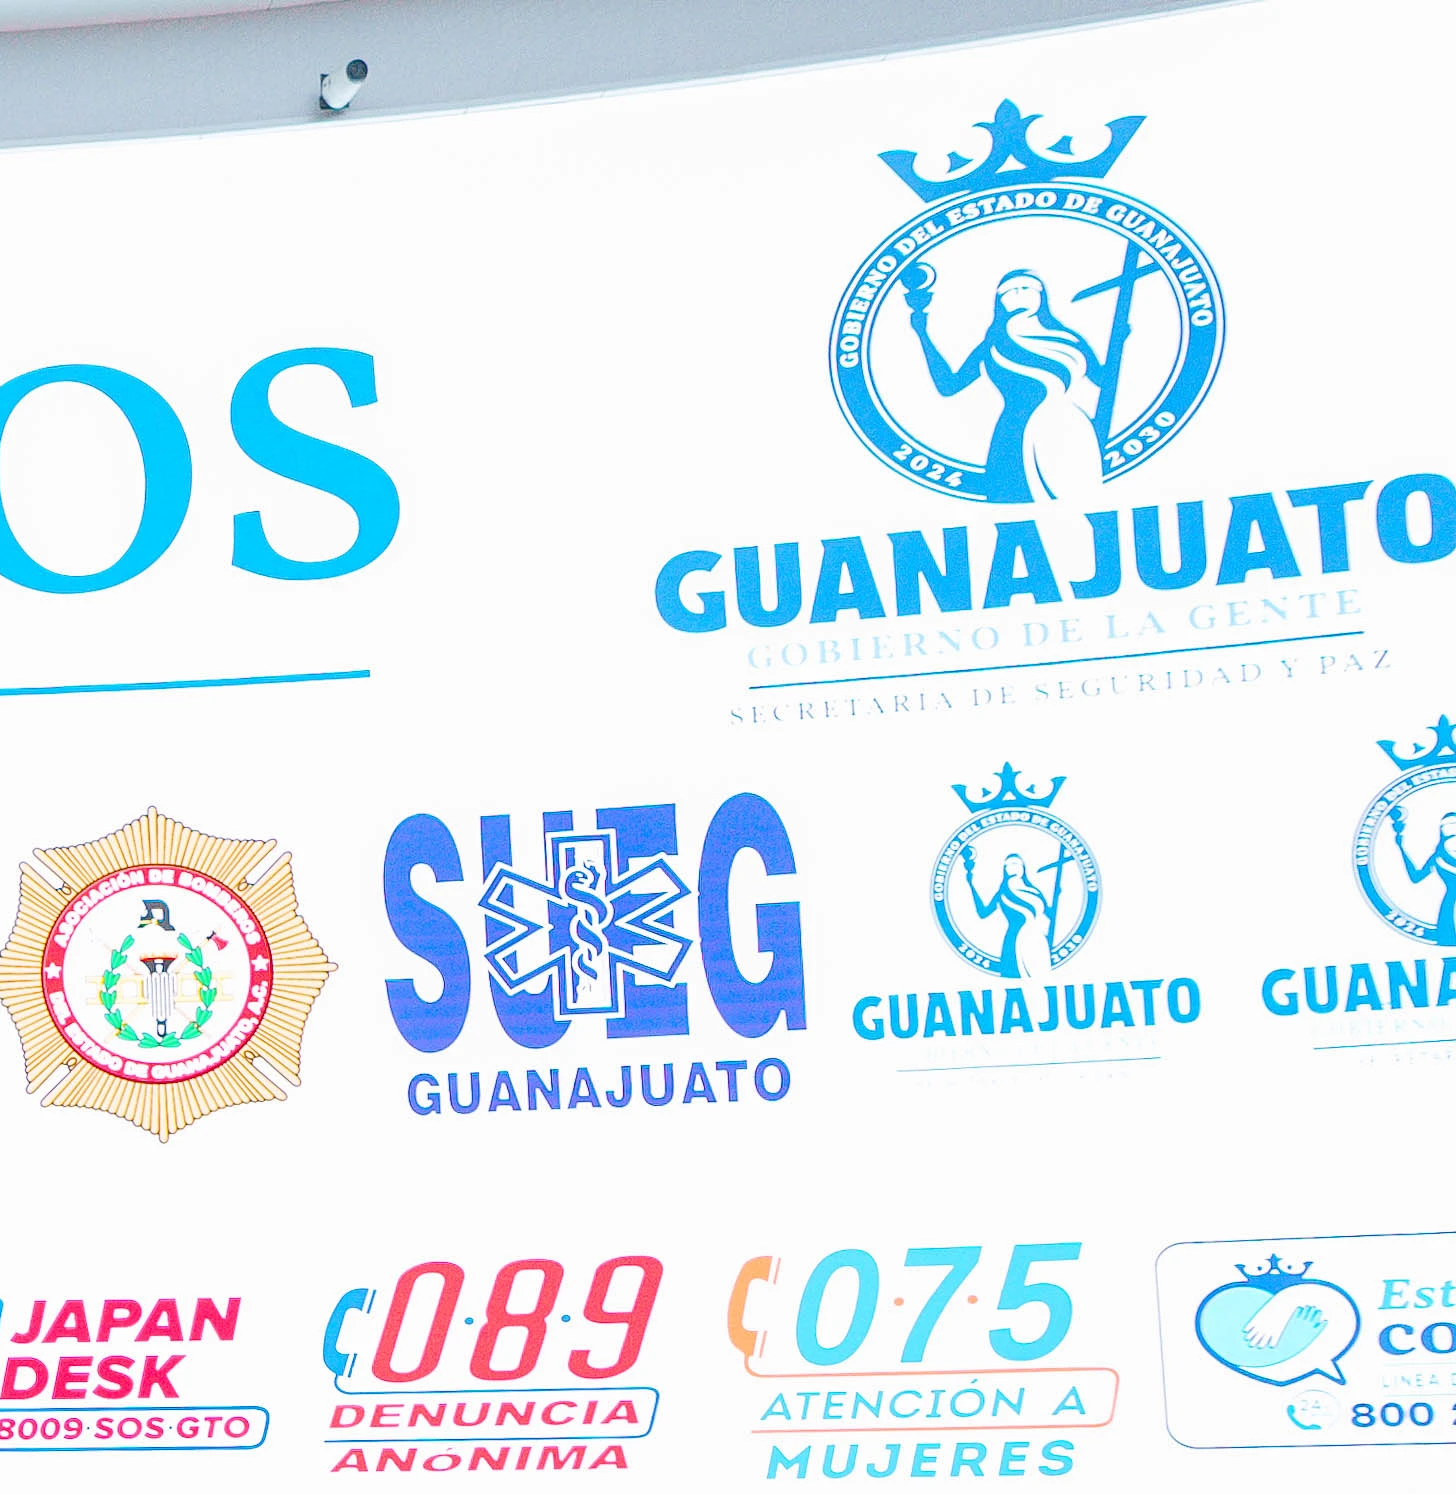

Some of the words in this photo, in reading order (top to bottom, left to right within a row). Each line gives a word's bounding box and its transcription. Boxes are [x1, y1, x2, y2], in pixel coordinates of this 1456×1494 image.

[840, 256, 897, 368] GOBIERNO
[894, 221, 944, 256] DEL
[947, 191, 1057, 225] ESTADO
[1064, 193, 1103, 214] DE
[1106, 203, 1214, 327] GUANAJUATO
[892, 443, 963, 488] 2024
[1105, 411, 1176, 469] 2030
[654, 472, 1456, 633] GUANAJUATO
[746, 624, 1002, 670] GOBIERNO
[1023, 618, 1086, 648] DE
[1106, 609, 1167, 640] LA
[1189, 588, 1365, 631] GENTE
[972, 683, 1018, 708] DE
[1034, 662, 1265, 703] SEGURIDAD
[1280, 657, 1300, 679] Y
[1319, 648, 1394, 676] PAZ
[852, 977, 1201, 1041] GUANAJUATO
[407, 1057, 790, 1115] GUANAJUATO
[10, 1297, 242, 1344] JAPAN
[0, 1354, 187, 1399] DESK
[761, 1379, 1025, 1420] ATENCIÓN
[1052, 1386, 1086, 1415] A
[330, 1400, 639, 1428] DENUNCIA
[1351, 1402, 1434, 1428] 800
[767, 1439, 1074, 1479] MUJERES
